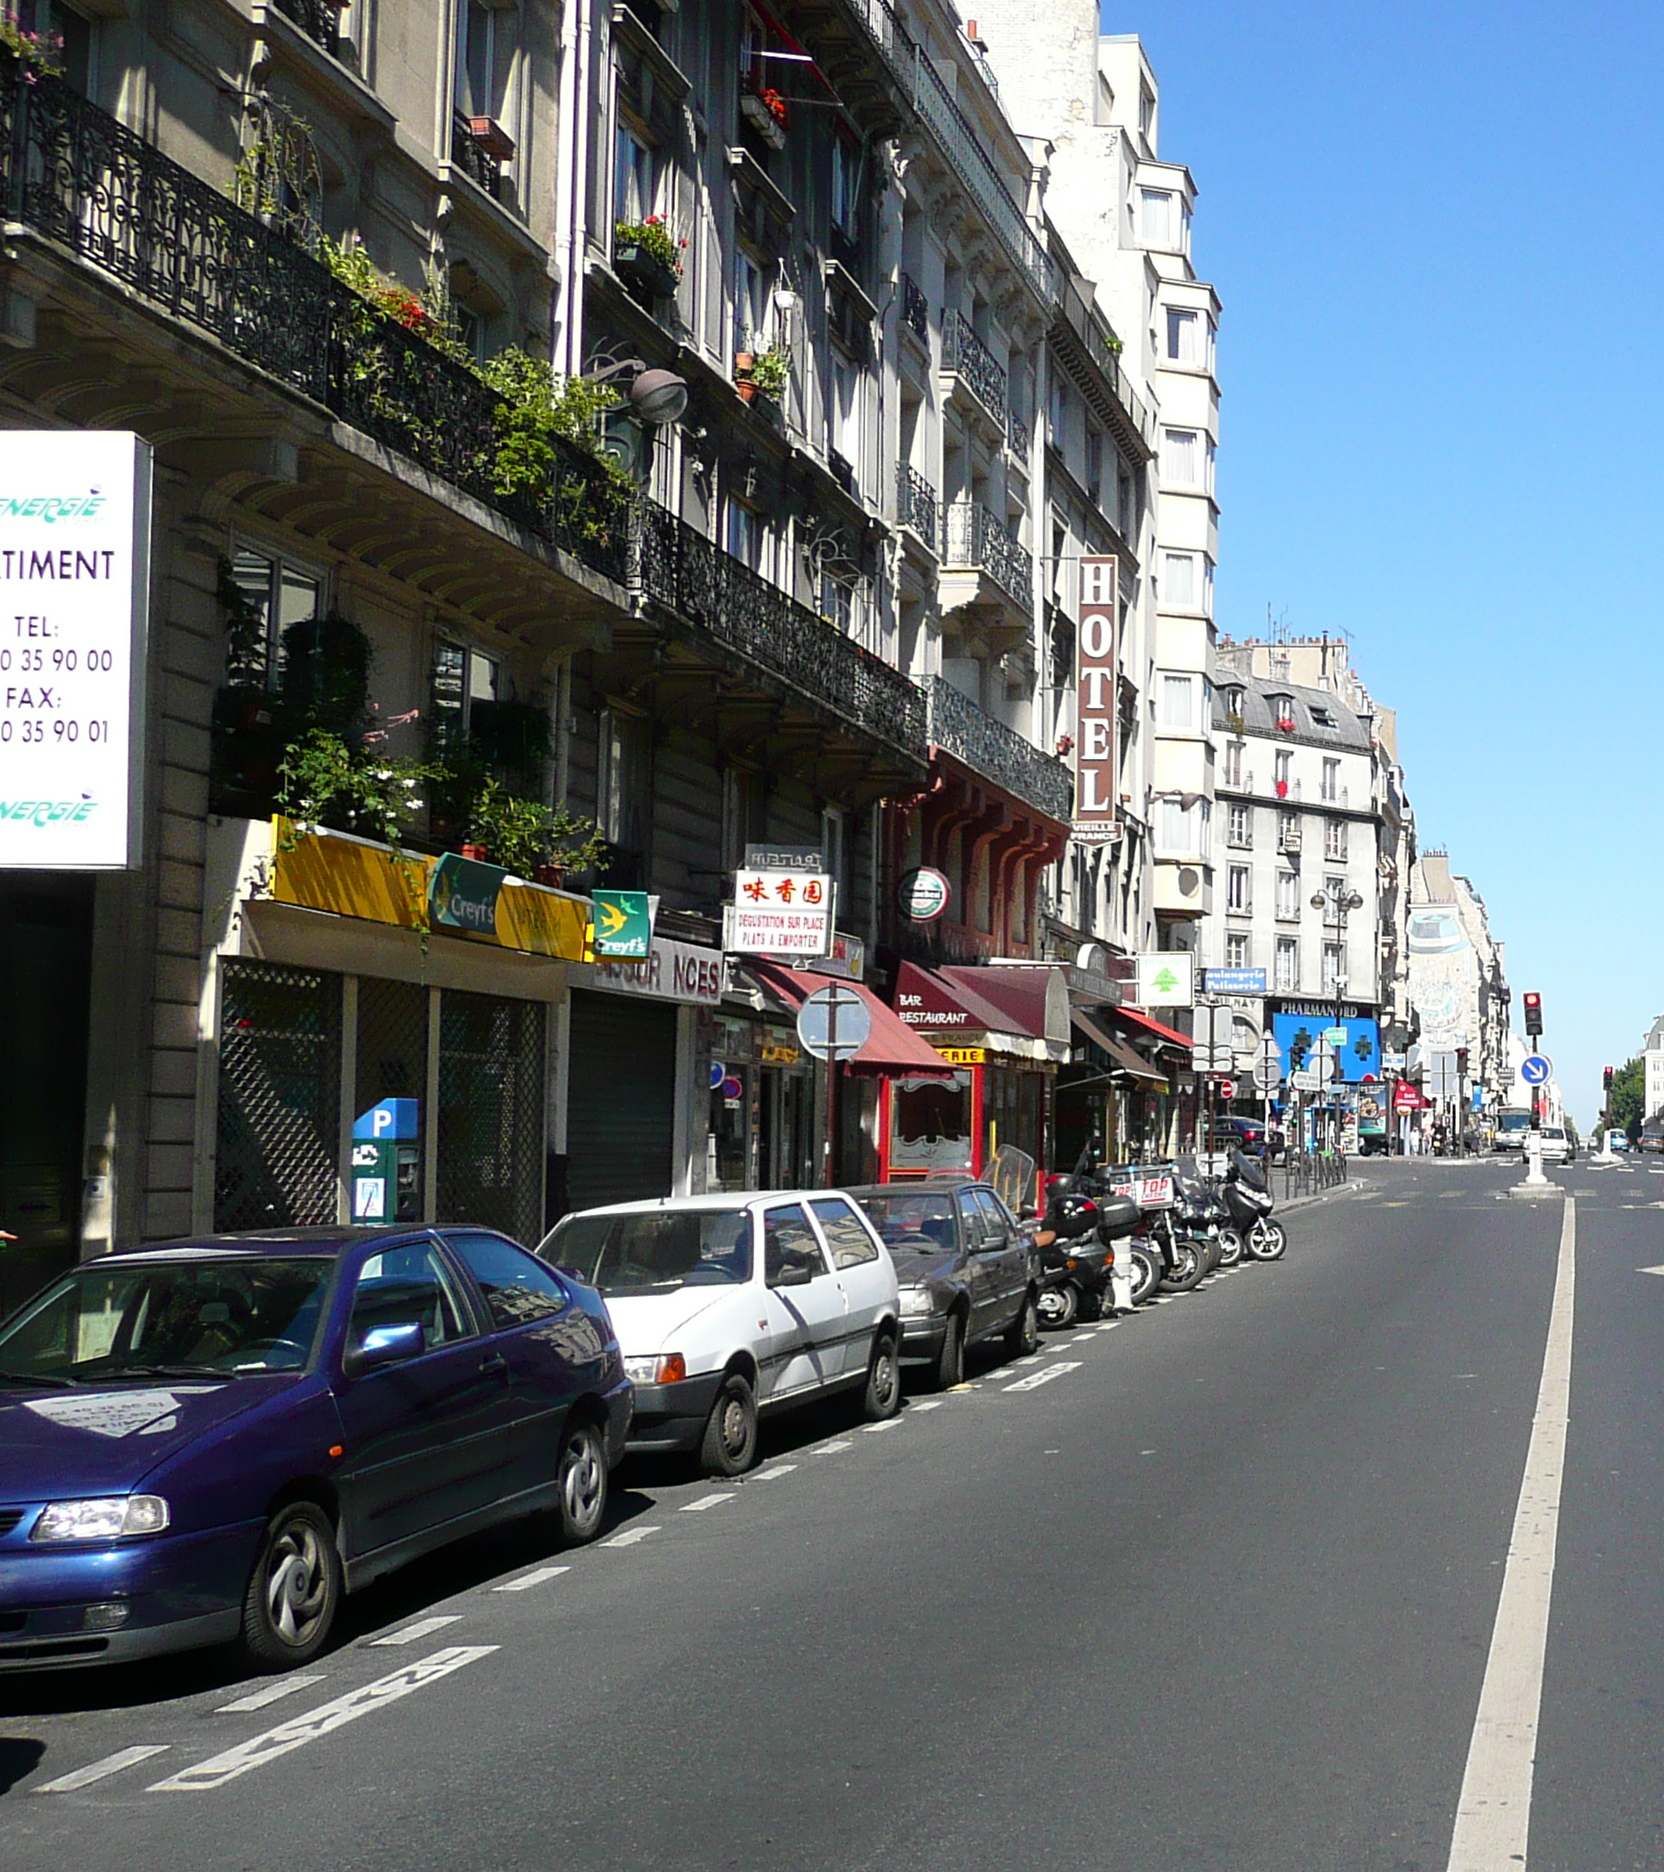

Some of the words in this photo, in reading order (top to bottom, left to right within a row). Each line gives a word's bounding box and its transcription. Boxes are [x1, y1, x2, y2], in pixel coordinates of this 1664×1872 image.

[0, 550, 115, 580] TIMENT
[14, 616, 59, 637] TEL:
[21, 649, 43, 671] 35
[52, 649, 78, 671] 90
[87, 649, 113, 671] 00
[1080, 562, 1113, 812] HOTEL
[6, 687, 61, 709] FAX:
[22, 720, 44, 742] 35
[53, 719, 79, 742] 90
[88, 720, 108, 743] 01
[1070, 832, 1118, 841] FRANCE
[1072, 824, 1117, 832] VIEILLE
[451, 893, 496, 927] Creyf's
[738, 914, 785, 929] DEGUSTATION
[787, 915, 800, 929] SUR
[803, 917, 825, 931] PLACE
[594, 936, 646, 954] Creyf's
[742, 932, 766, 946] PLATS
[769, 934, 774, 945] A
[778, 934, 818, 948] EMPORTER
[899, 994, 923, 1006] BAR
[898, 1012, 968, 1025] RESTAURANT
[373, 1110, 392, 1137] P
[1142, 1179, 1169, 1193] TOP
